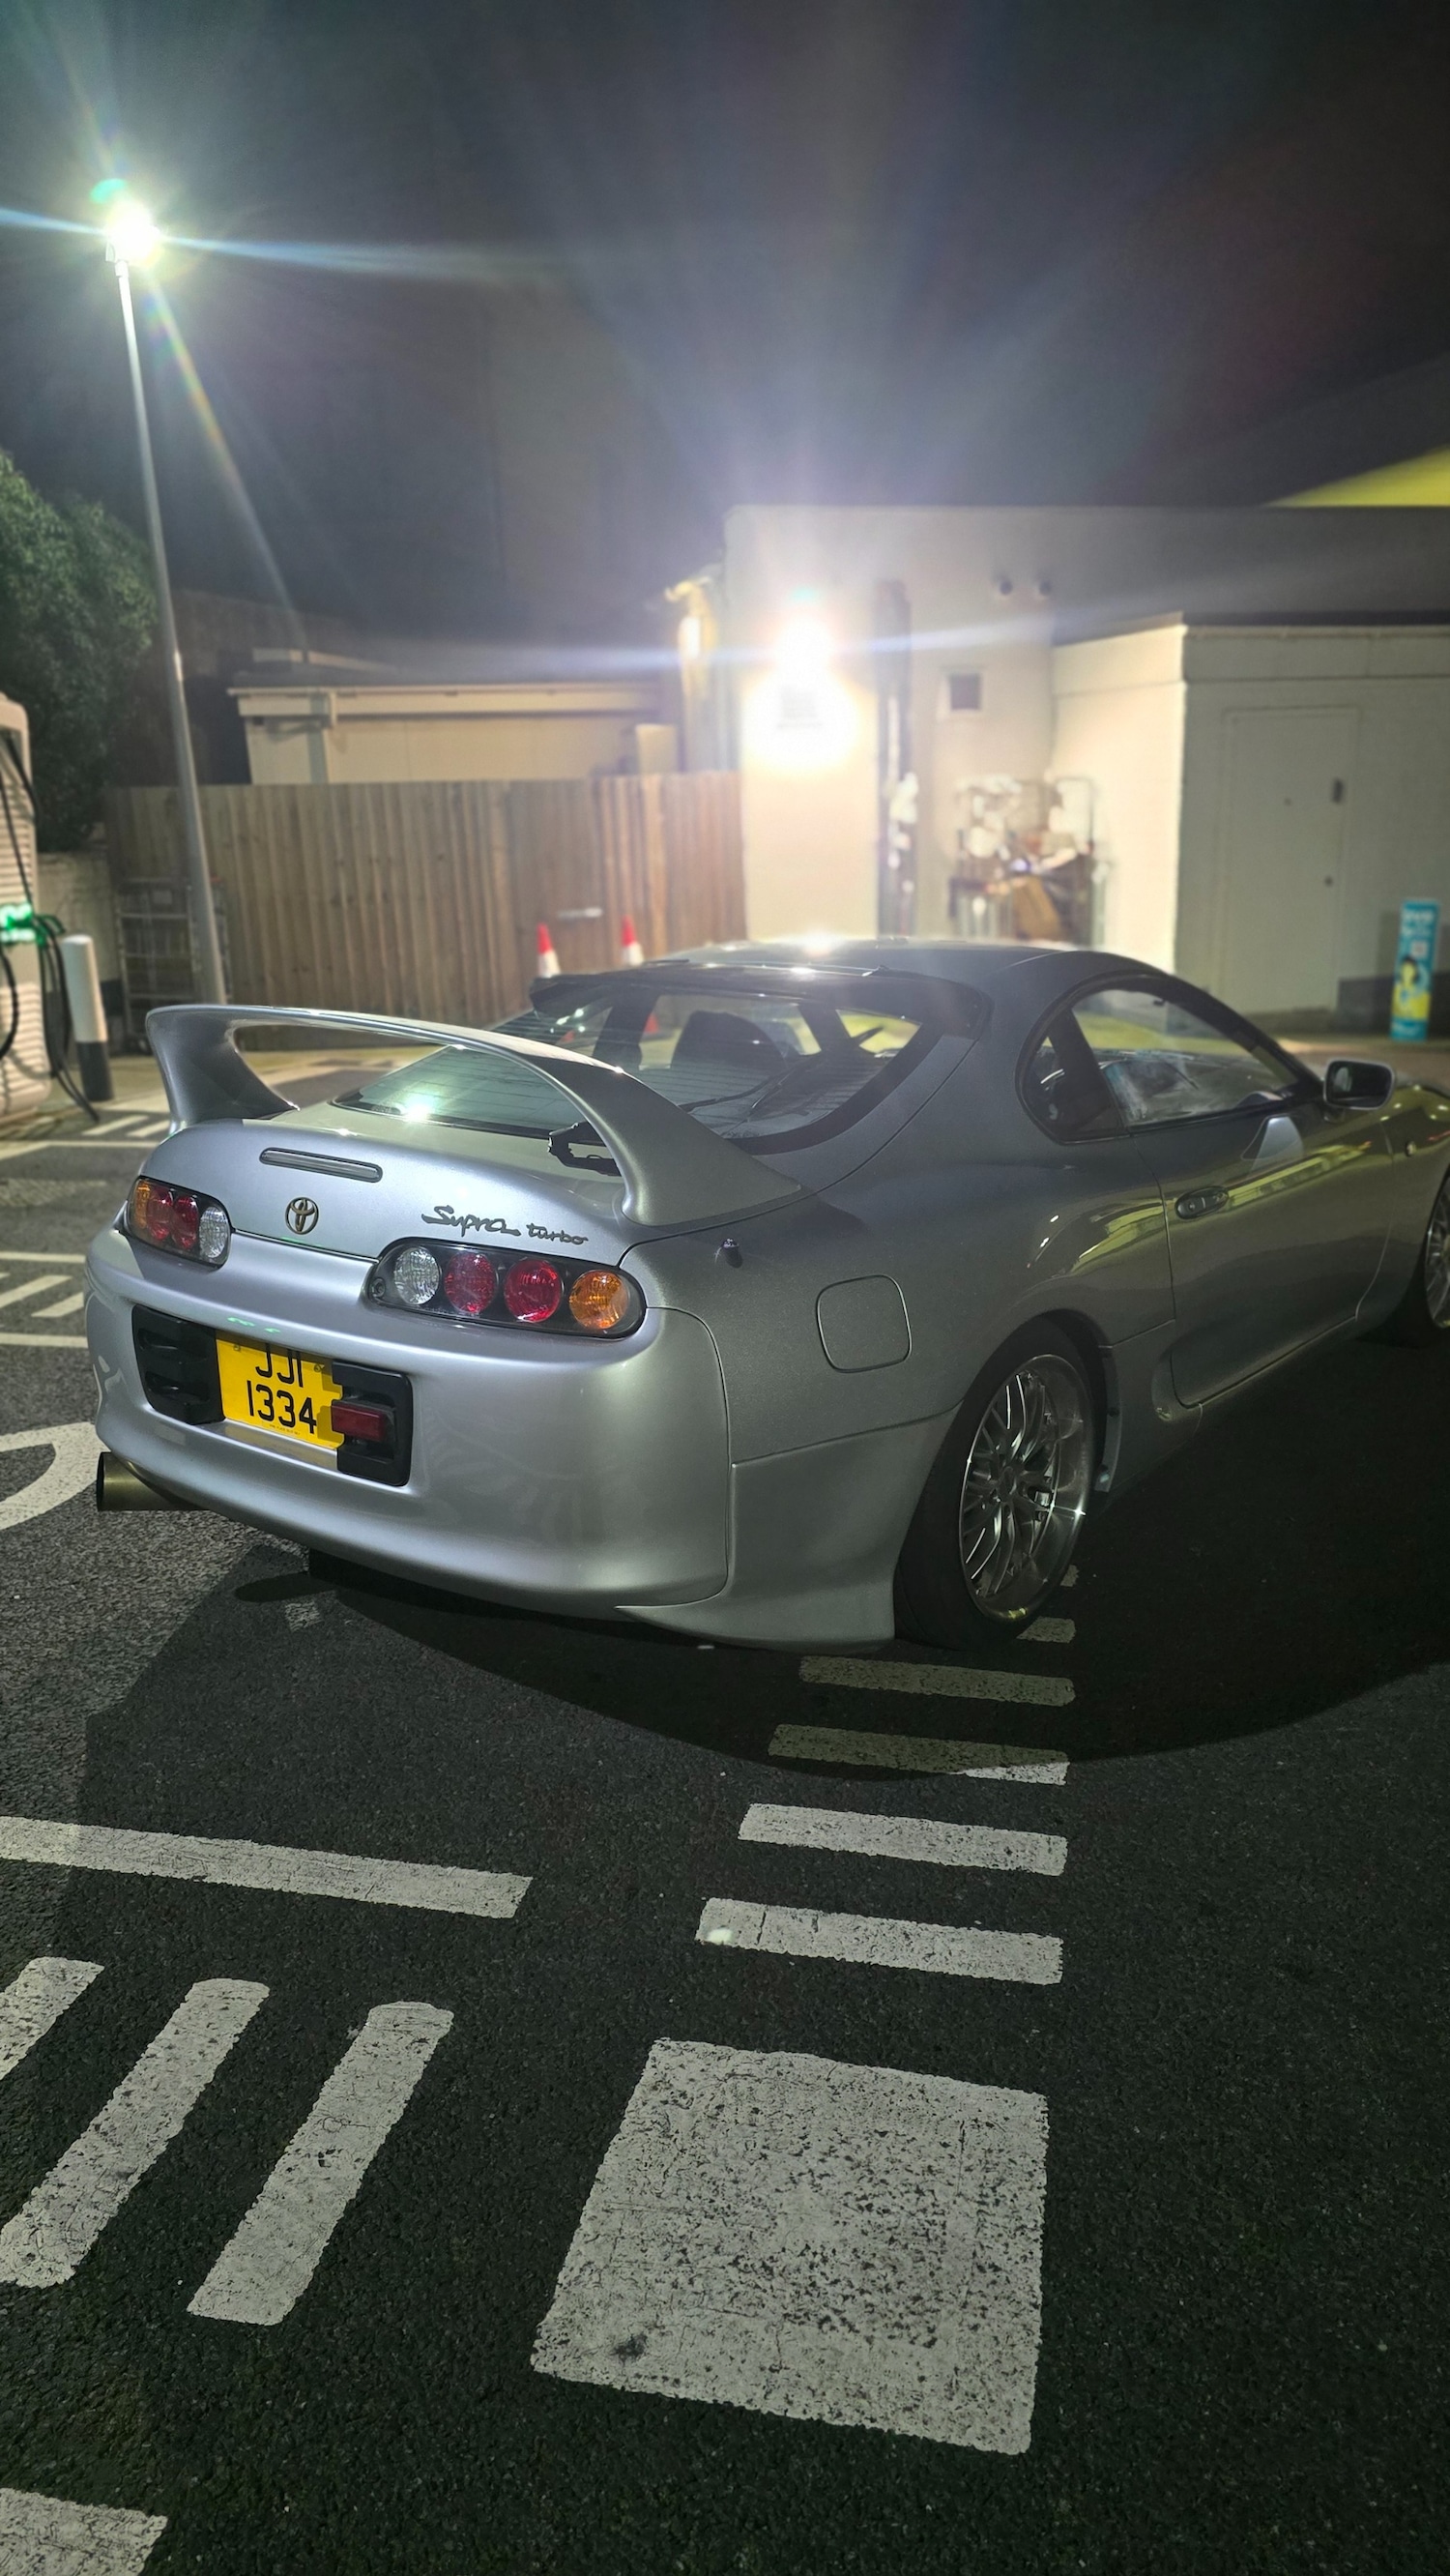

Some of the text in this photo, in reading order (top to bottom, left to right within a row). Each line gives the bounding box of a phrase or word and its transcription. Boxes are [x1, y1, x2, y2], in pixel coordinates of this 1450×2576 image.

[421, 1205, 589, 1244] Supra turbo
[246, 1380, 317, 1434] 1334
